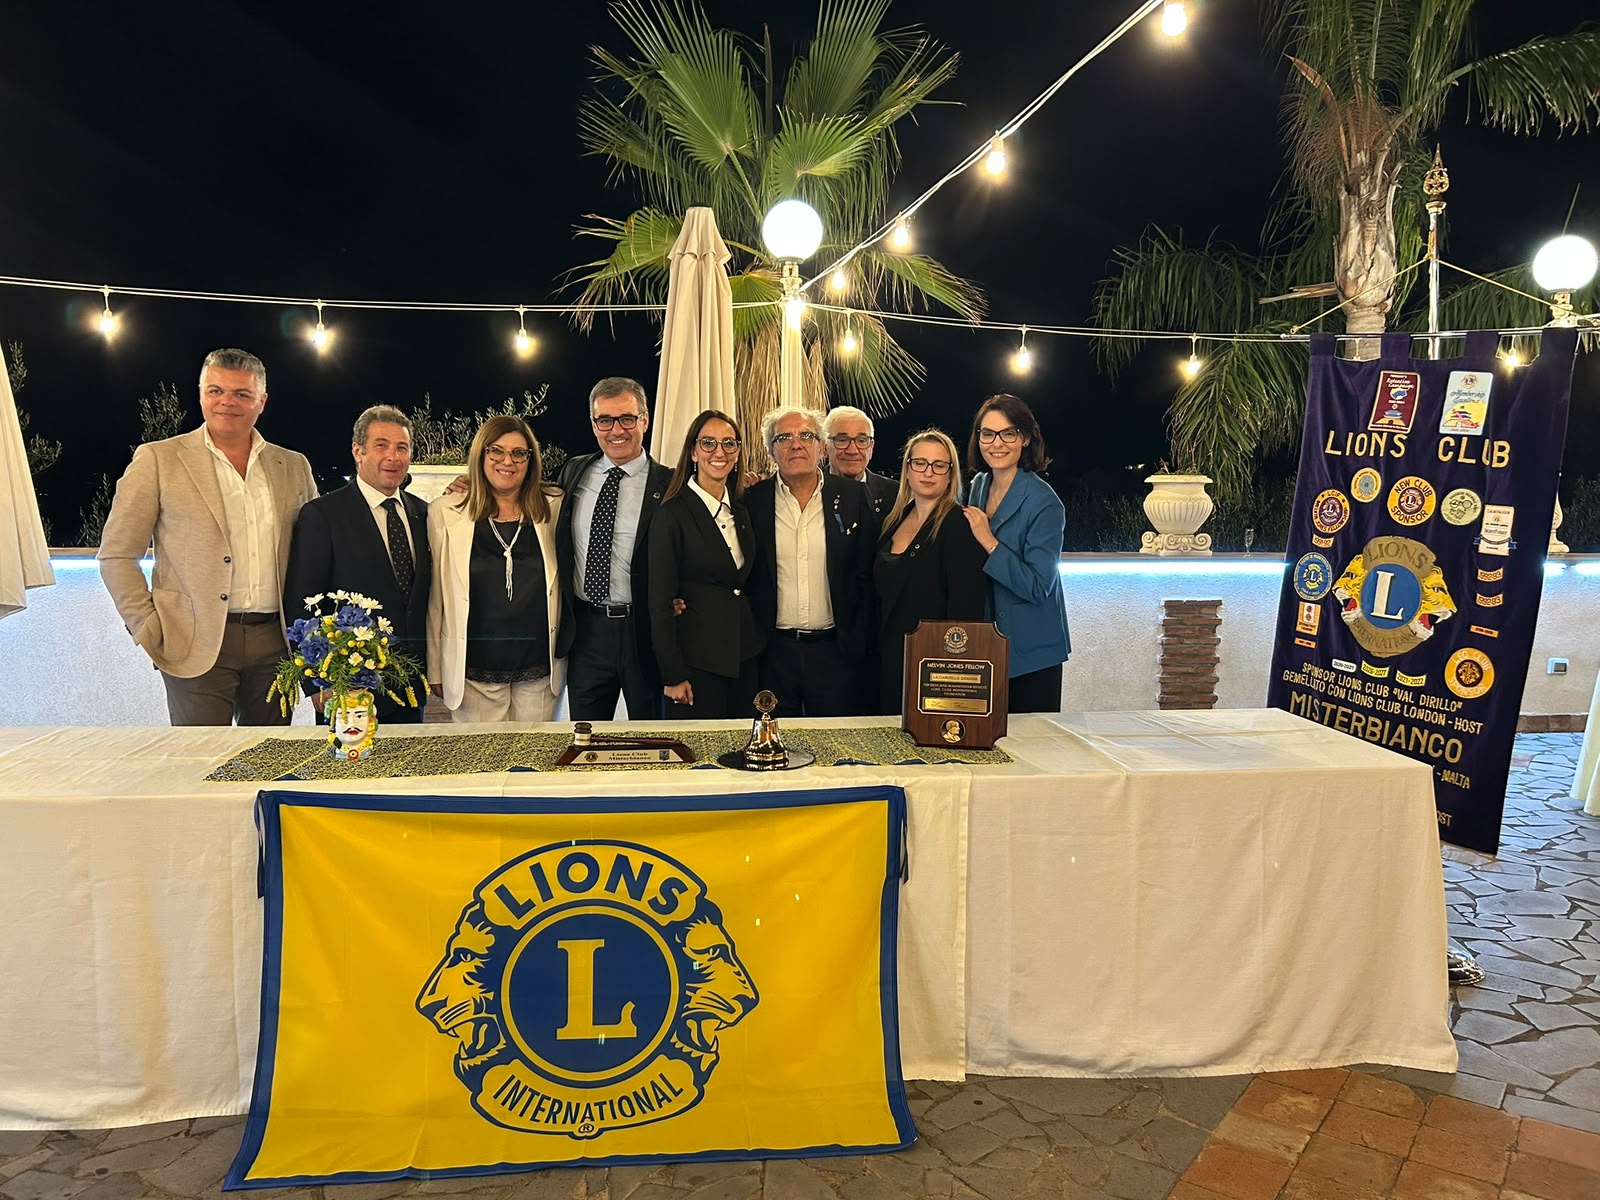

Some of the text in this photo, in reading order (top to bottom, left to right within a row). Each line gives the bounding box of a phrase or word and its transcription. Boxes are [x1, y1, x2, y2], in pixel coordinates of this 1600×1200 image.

[1325, 430, 1511, 468] LIONS CLUB
[1394, 480, 1410, 495] NEW
[1414, 479, 1433, 498] CLUB
[1390, 505, 1429, 523] SPONSOR
[1366, 541, 1428, 569] LIONS
[1370, 570, 1404, 620] L
[1353, 617, 1418, 649] INTERNATIONAL
[1453, 651, 1490, 671] LEO CLUB
[1302, 662, 1336, 683] SPONSOR
[1338, 674, 1362, 691] LIONS
[1365, 682, 1390, 698] CLUB
[1449, 676, 1486, 696] SPONSOR
[1289, 690, 1463, 764] MISTERBIANCO
[1327, 683, 1347, 699] CON
[1347, 690, 1374, 708] LIONS
[1375, 698, 1401, 714] CLUB
[1403, 704, 1446, 726] LONDON
[1454, 717, 1484, 735] HOST
[1441, 769, 1471, 789] MALTA
[493, 851, 689, 920] LIONS
[556, 939, 637, 1040] L
[492, 1072, 684, 1125] INTERNATIONAL
